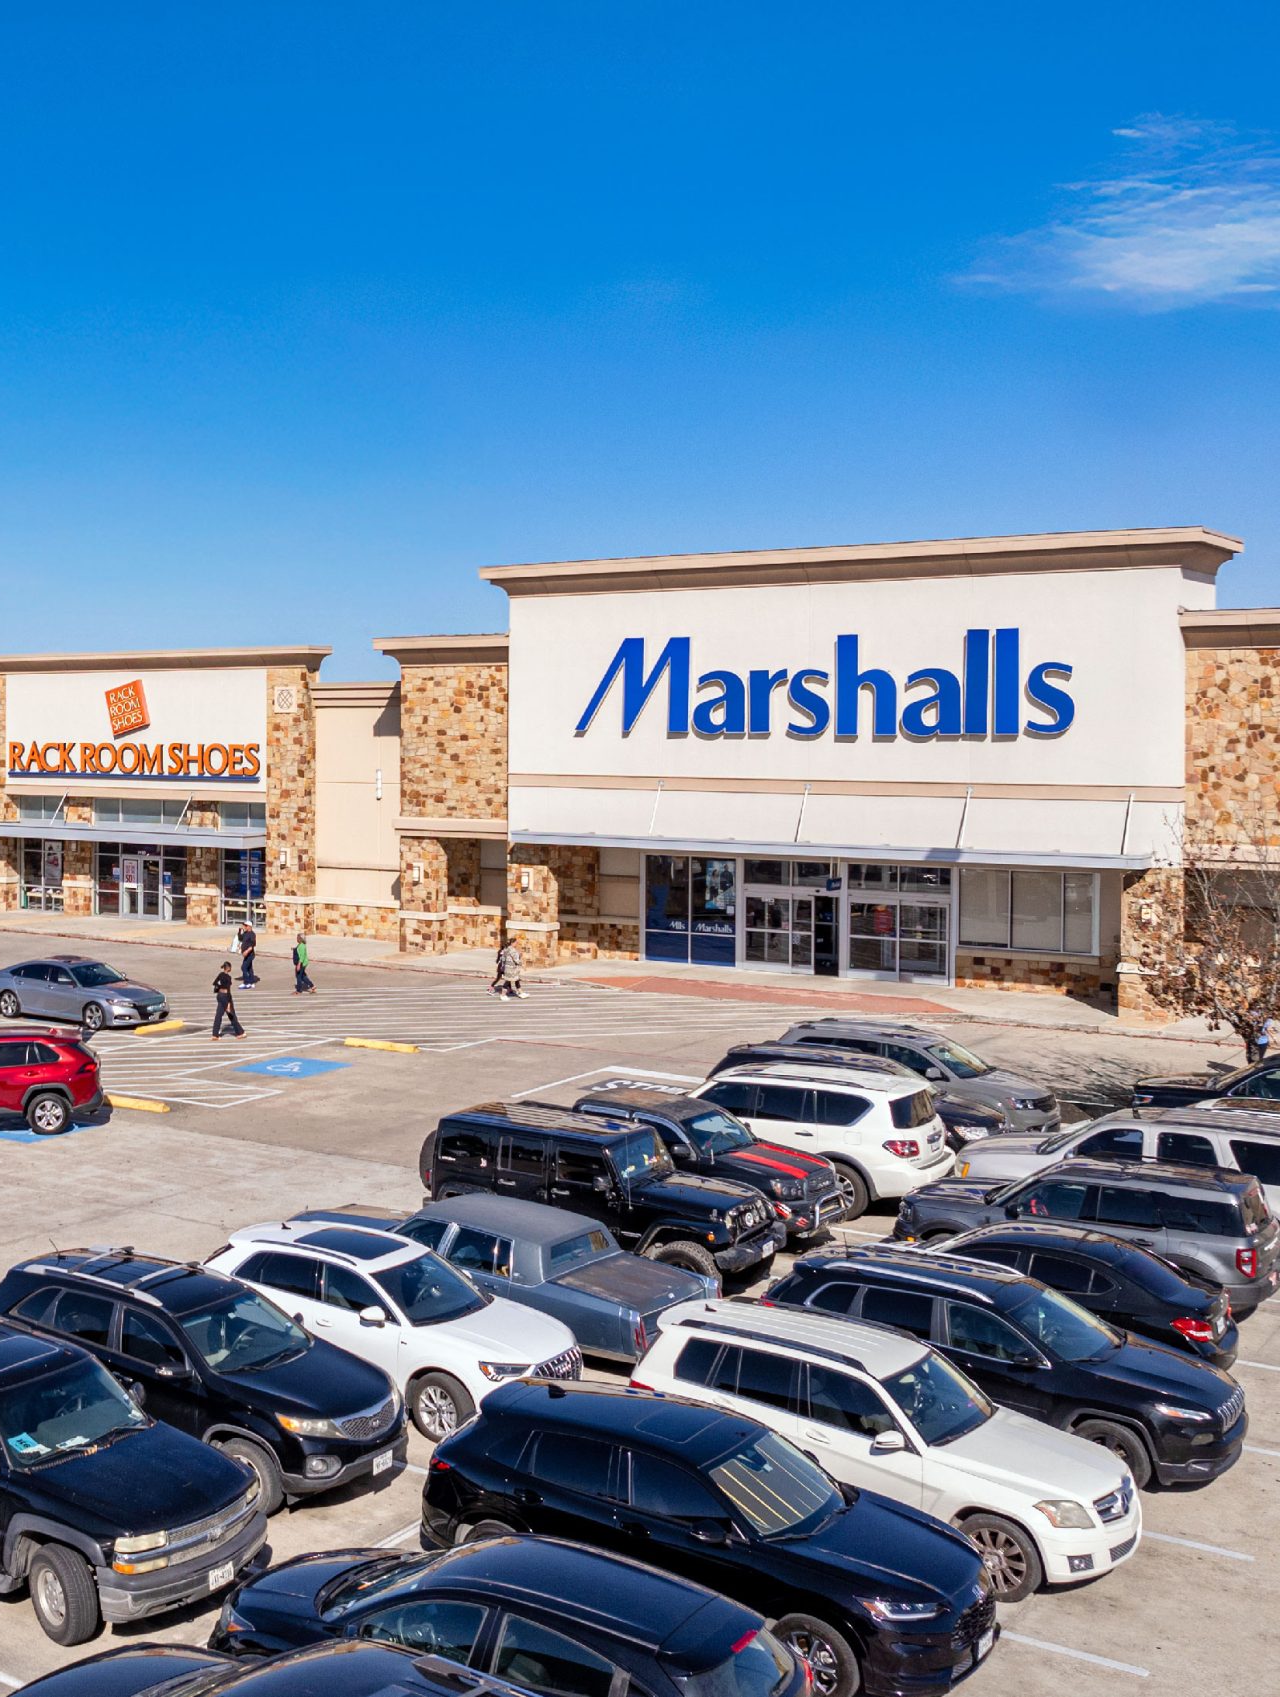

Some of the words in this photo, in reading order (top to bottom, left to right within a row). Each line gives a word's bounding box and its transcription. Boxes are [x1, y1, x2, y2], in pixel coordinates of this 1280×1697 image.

[575, 628, 1076, 737] Marshalls
[109, 685, 136, 704] RACK
[110, 697, 141, 717] ROOM
[112, 710, 143, 730] SHOES
[9, 741, 75, 773] RACK
[80, 742, 163, 774] ROOM
[168, 742, 261, 777] SHOES
[695, 922, 733, 934] Marshalls
